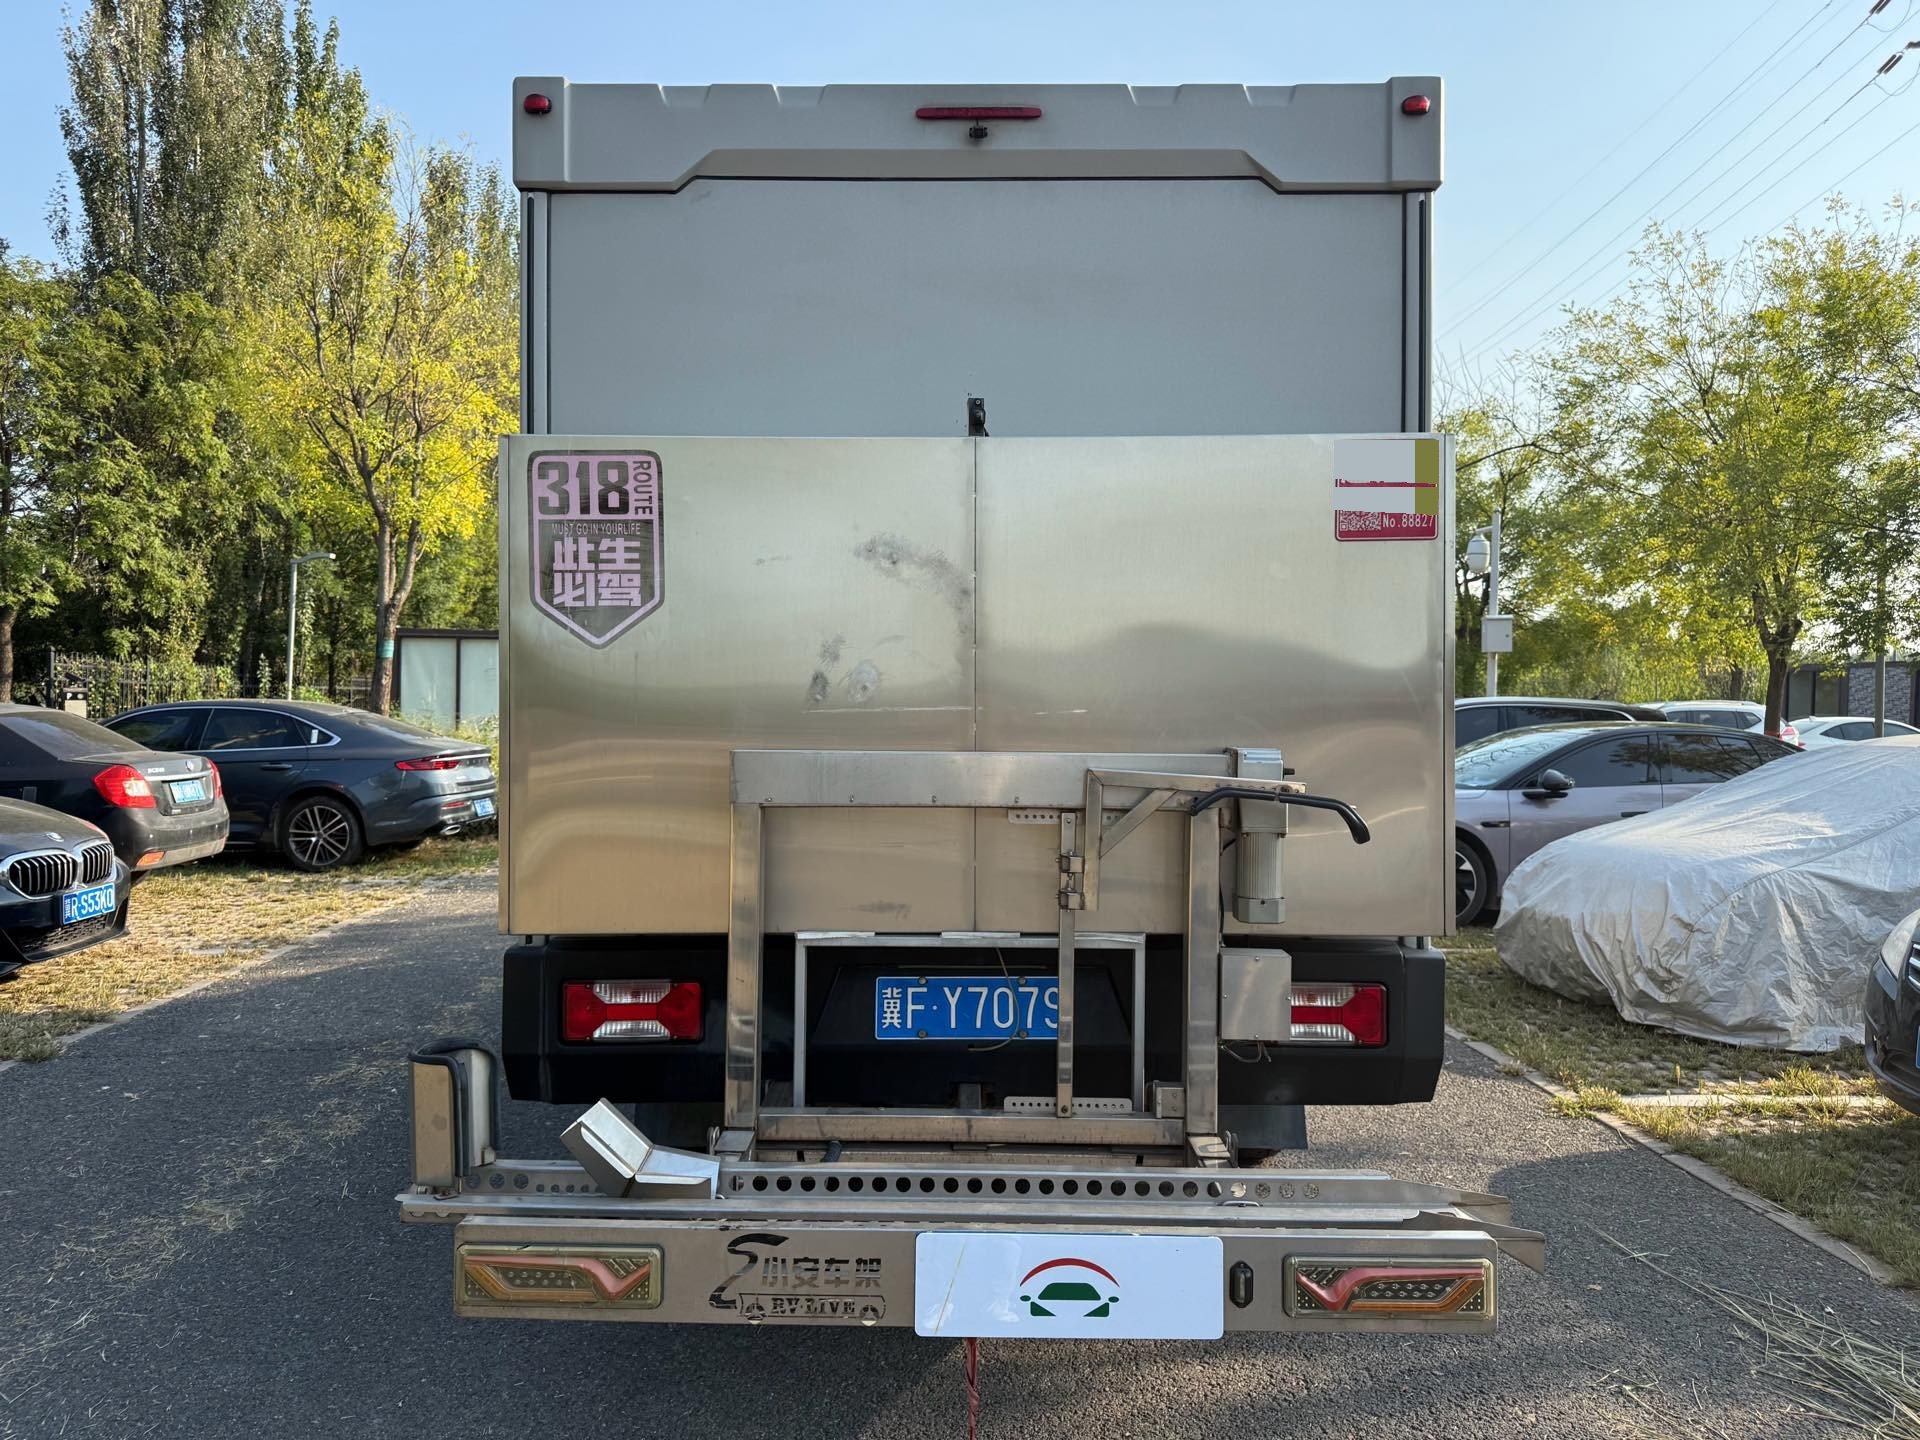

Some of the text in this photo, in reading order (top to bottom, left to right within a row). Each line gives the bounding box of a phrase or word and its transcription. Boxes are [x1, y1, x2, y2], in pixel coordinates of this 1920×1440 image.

[537, 460, 630, 515] 318
[632, 460, 653, 515] ROUTE
[551, 522, 574, 535] MUST
[576, 522, 589, 535] GO
[590, 522, 599, 535] IN
[553, 537, 641, 571] 此生
[553, 572, 642, 607] 必驾
